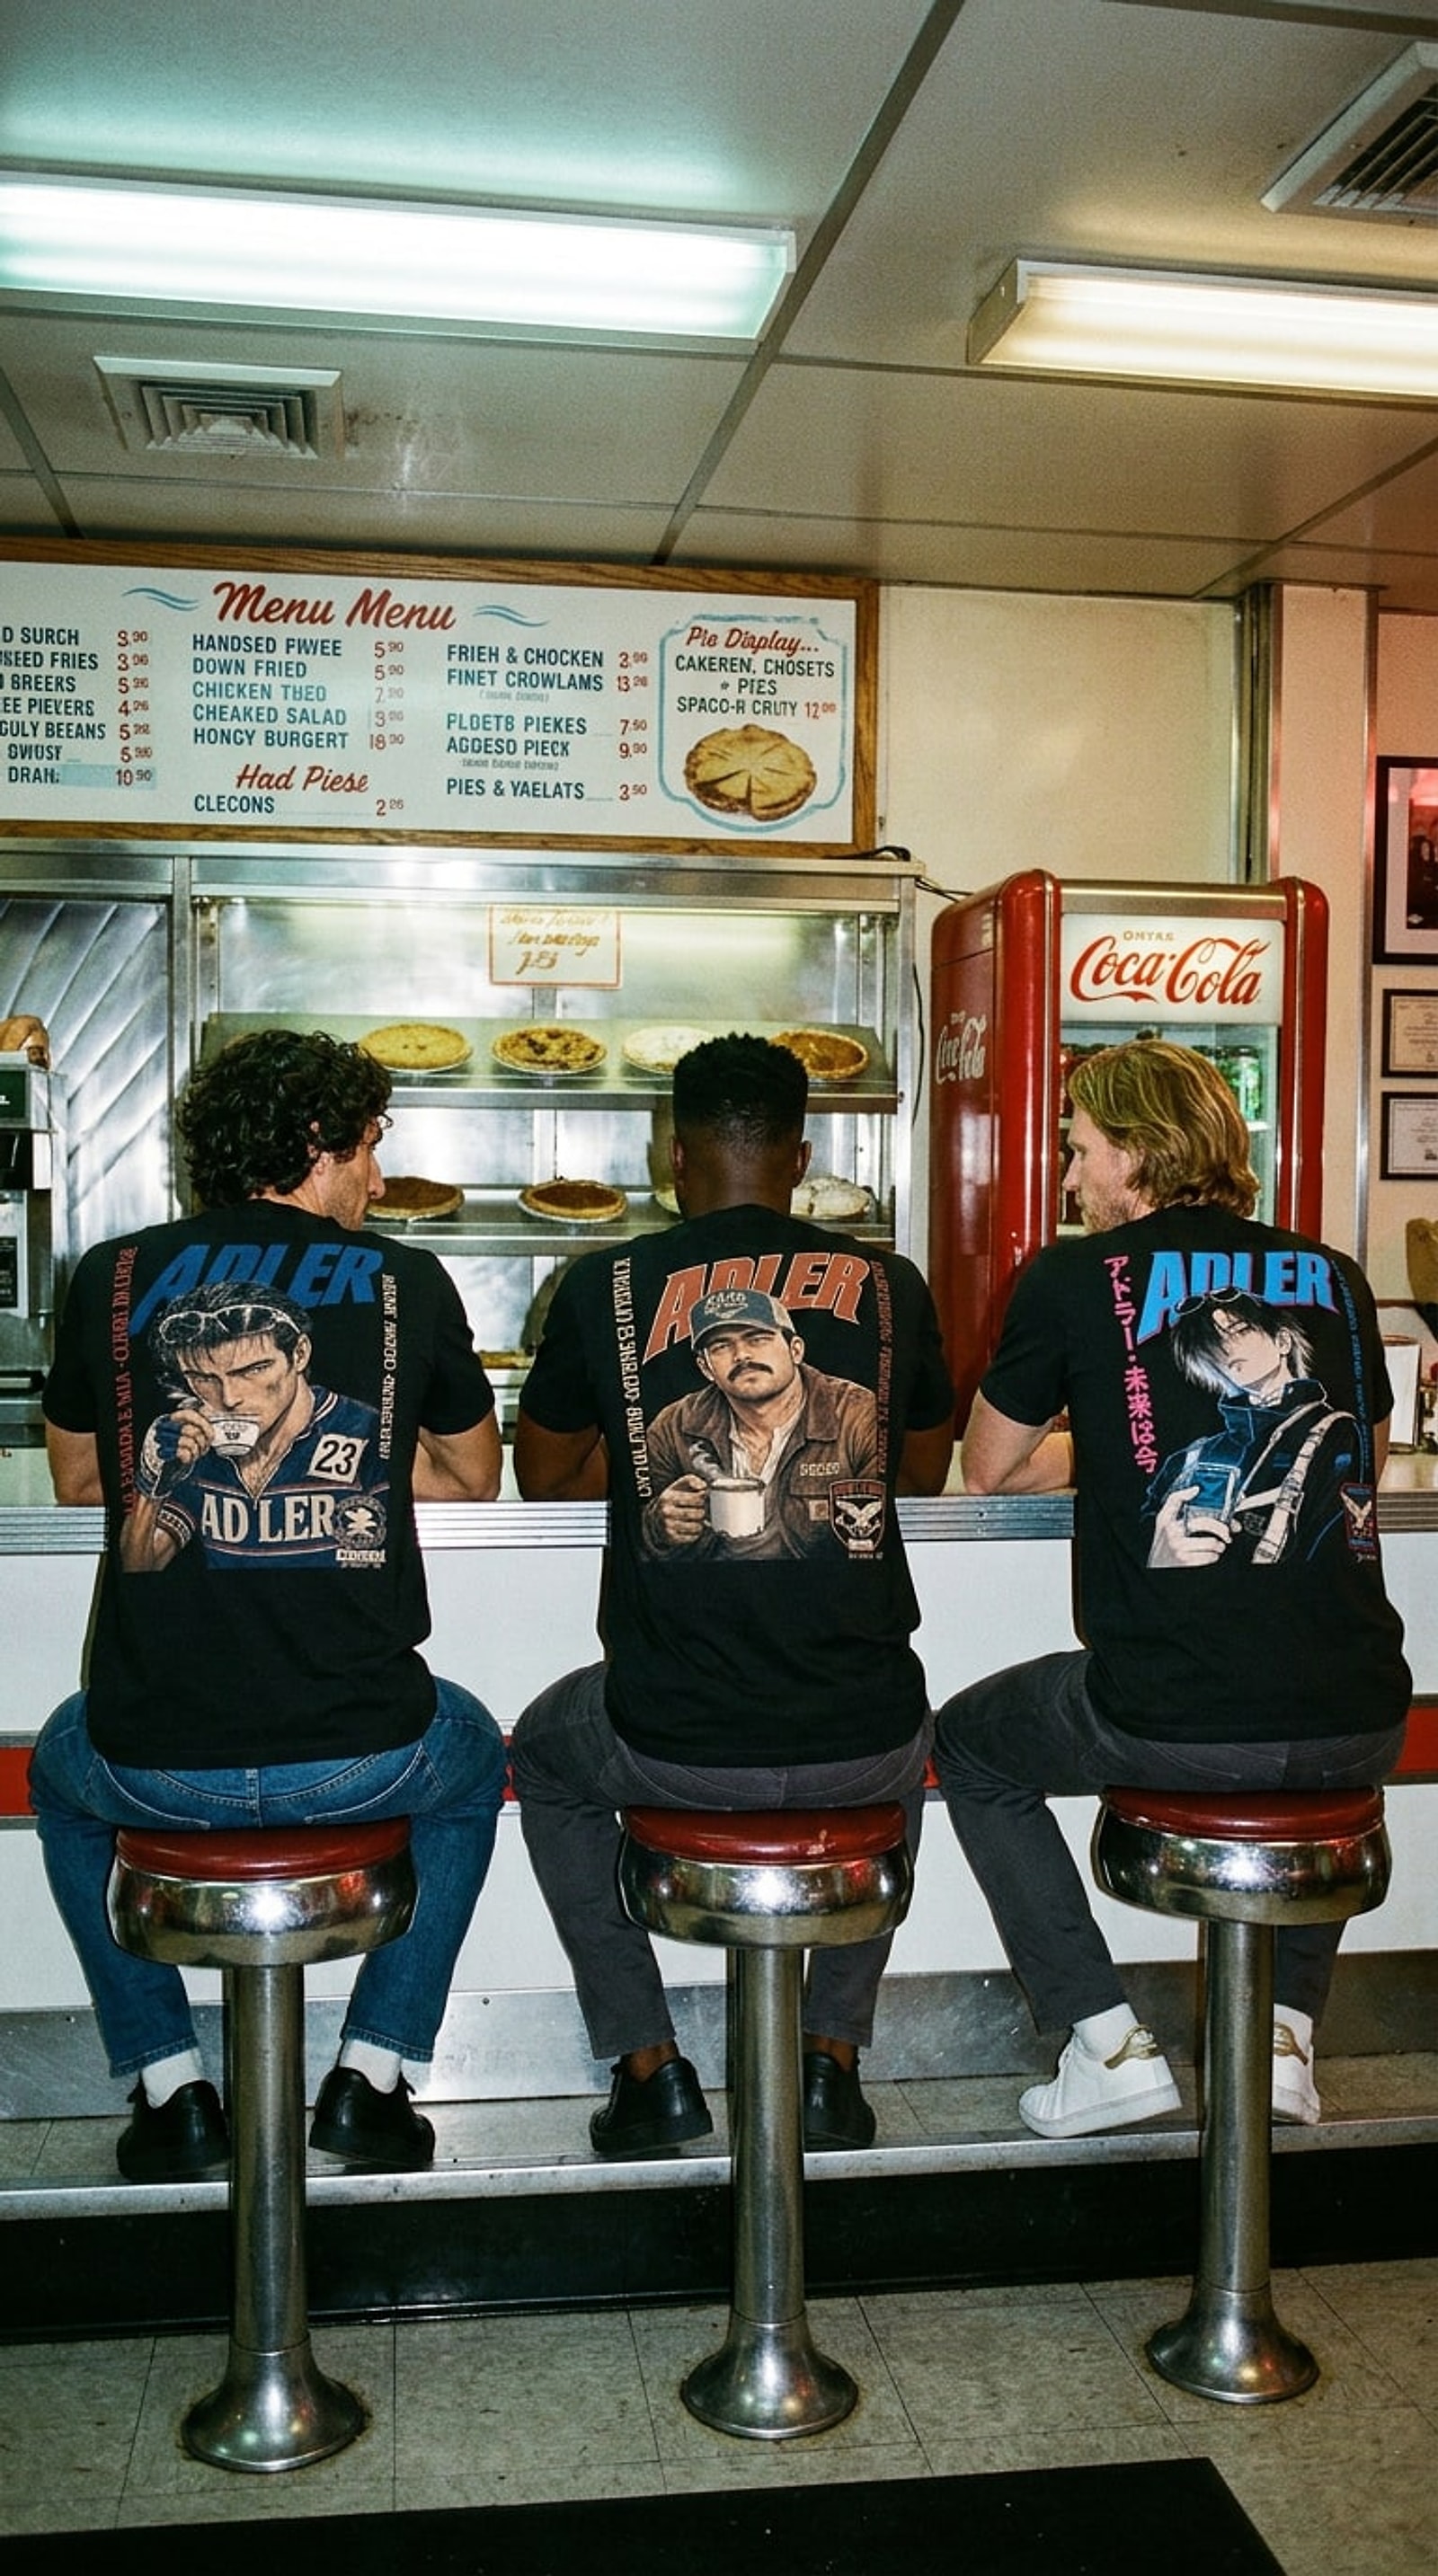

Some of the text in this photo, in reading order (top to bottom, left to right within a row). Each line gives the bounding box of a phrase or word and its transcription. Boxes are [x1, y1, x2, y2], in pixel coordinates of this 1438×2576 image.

[213, 581, 456, 631] Menu Menu
[192, 634, 277, 654] HANDSED
[50, 652, 99, 670] FRIES
[506, 647, 519, 664] &
[524, 648, 603, 668] CHOCKEN
[192, 658, 245, 676] DOWN
[254, 660, 306, 678] FRIED
[764, 659, 835, 677] CHOSETS
[447, 668, 498, 687] FINET
[505, 670, 603, 692] CROWLAMS
[738, 678, 777, 696] PIES
[192, 681, 272, 701] CHICKEN
[192, 704, 279, 724] CHEAKED
[286, 707, 347, 725] SALAD
[45, 722, 106, 739] BEEANS
[264, 731, 349, 749] BURGERT
[235, 764, 297, 791] Had
[447, 778, 485, 795] PIES
[493, 779, 505, 796] &
[510, 781, 584, 800] YAELATS
[194, 794, 275, 814] CLECONS
[315, 1439, 357, 1476] 23
